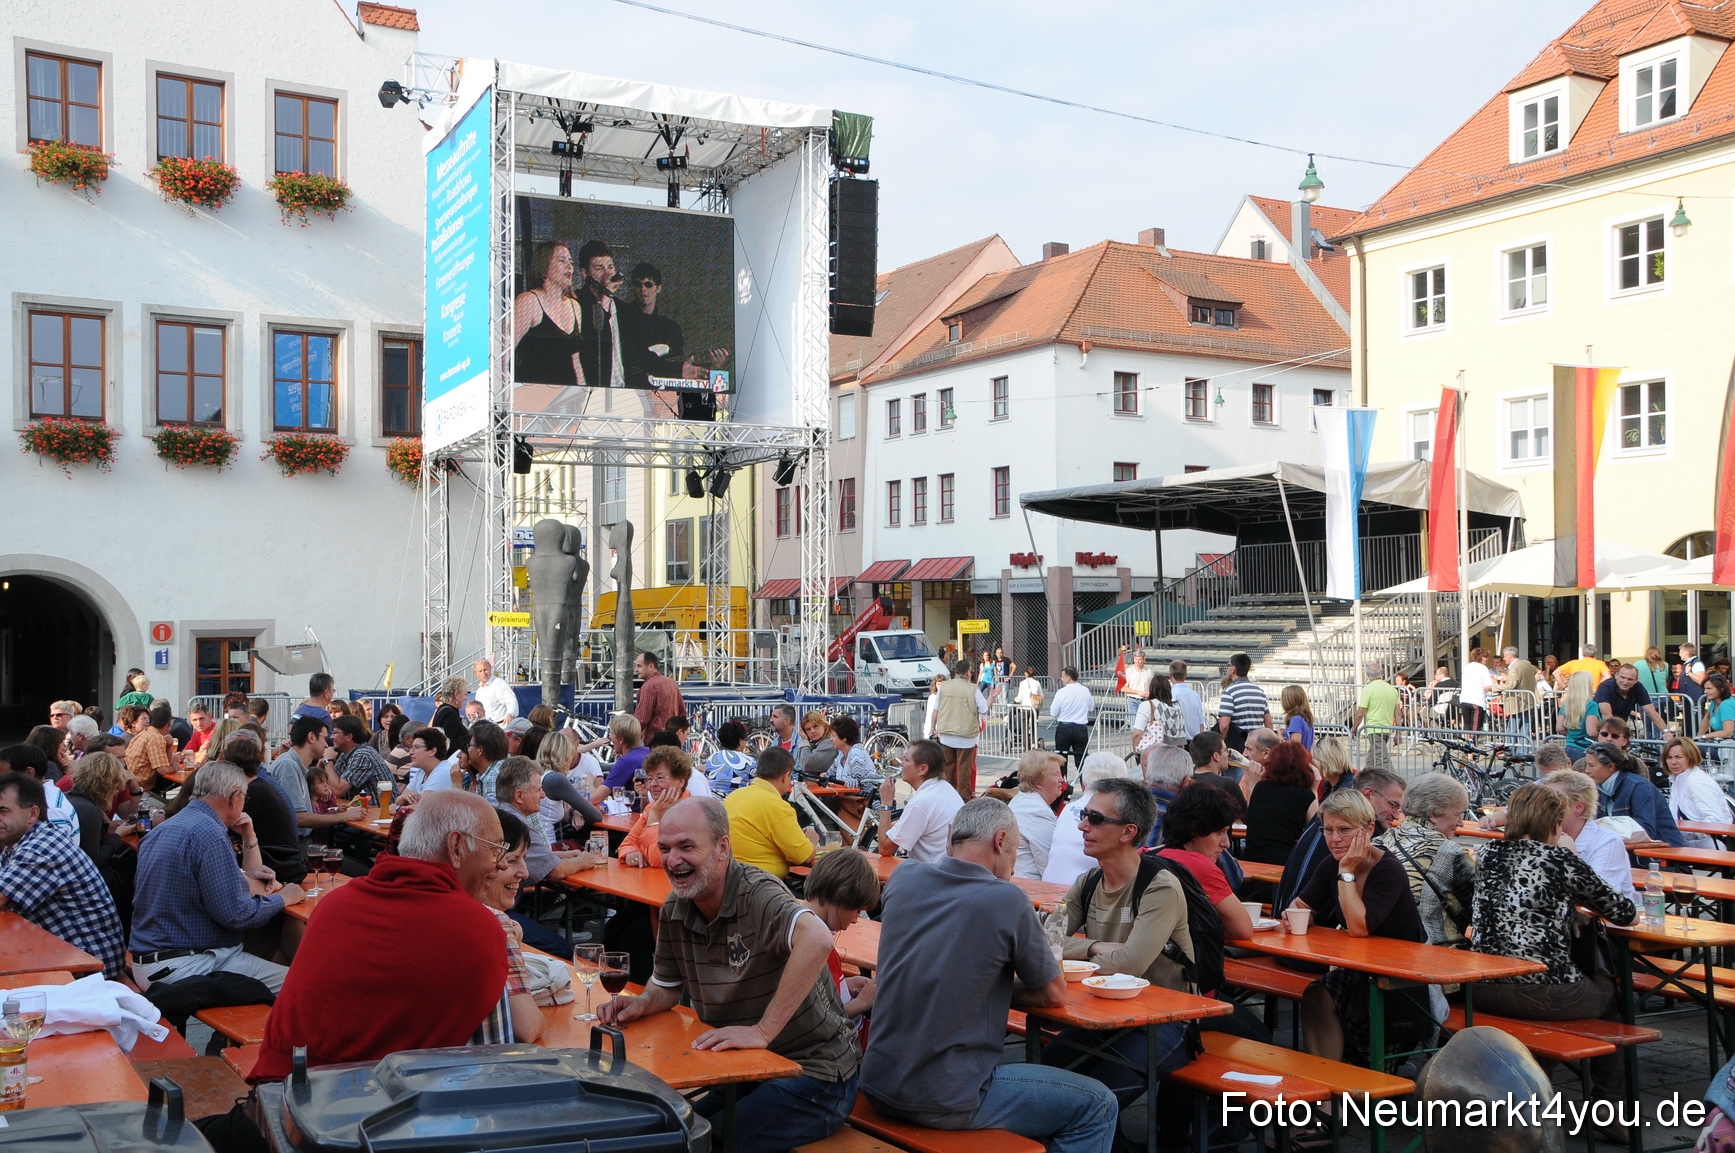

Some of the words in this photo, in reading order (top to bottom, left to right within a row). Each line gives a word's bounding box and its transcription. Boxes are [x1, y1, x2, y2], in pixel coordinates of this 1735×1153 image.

[436, 130, 477, 182] Messeauftritte
[446, 170, 472, 204] Roadshows
[435, 183, 479, 232] Sportveranstaltungen
[431, 214, 464, 253] Installationen
[435, 251, 475, 290] Firmeneröffnungen
[441, 292, 466, 320] Kongresse
[442, 322, 462, 343] Konzerte
[695, 379, 709, 389] TV
[1075, 551, 1118, 569] Döpfer
[493, 614, 530, 625] Typisierung
